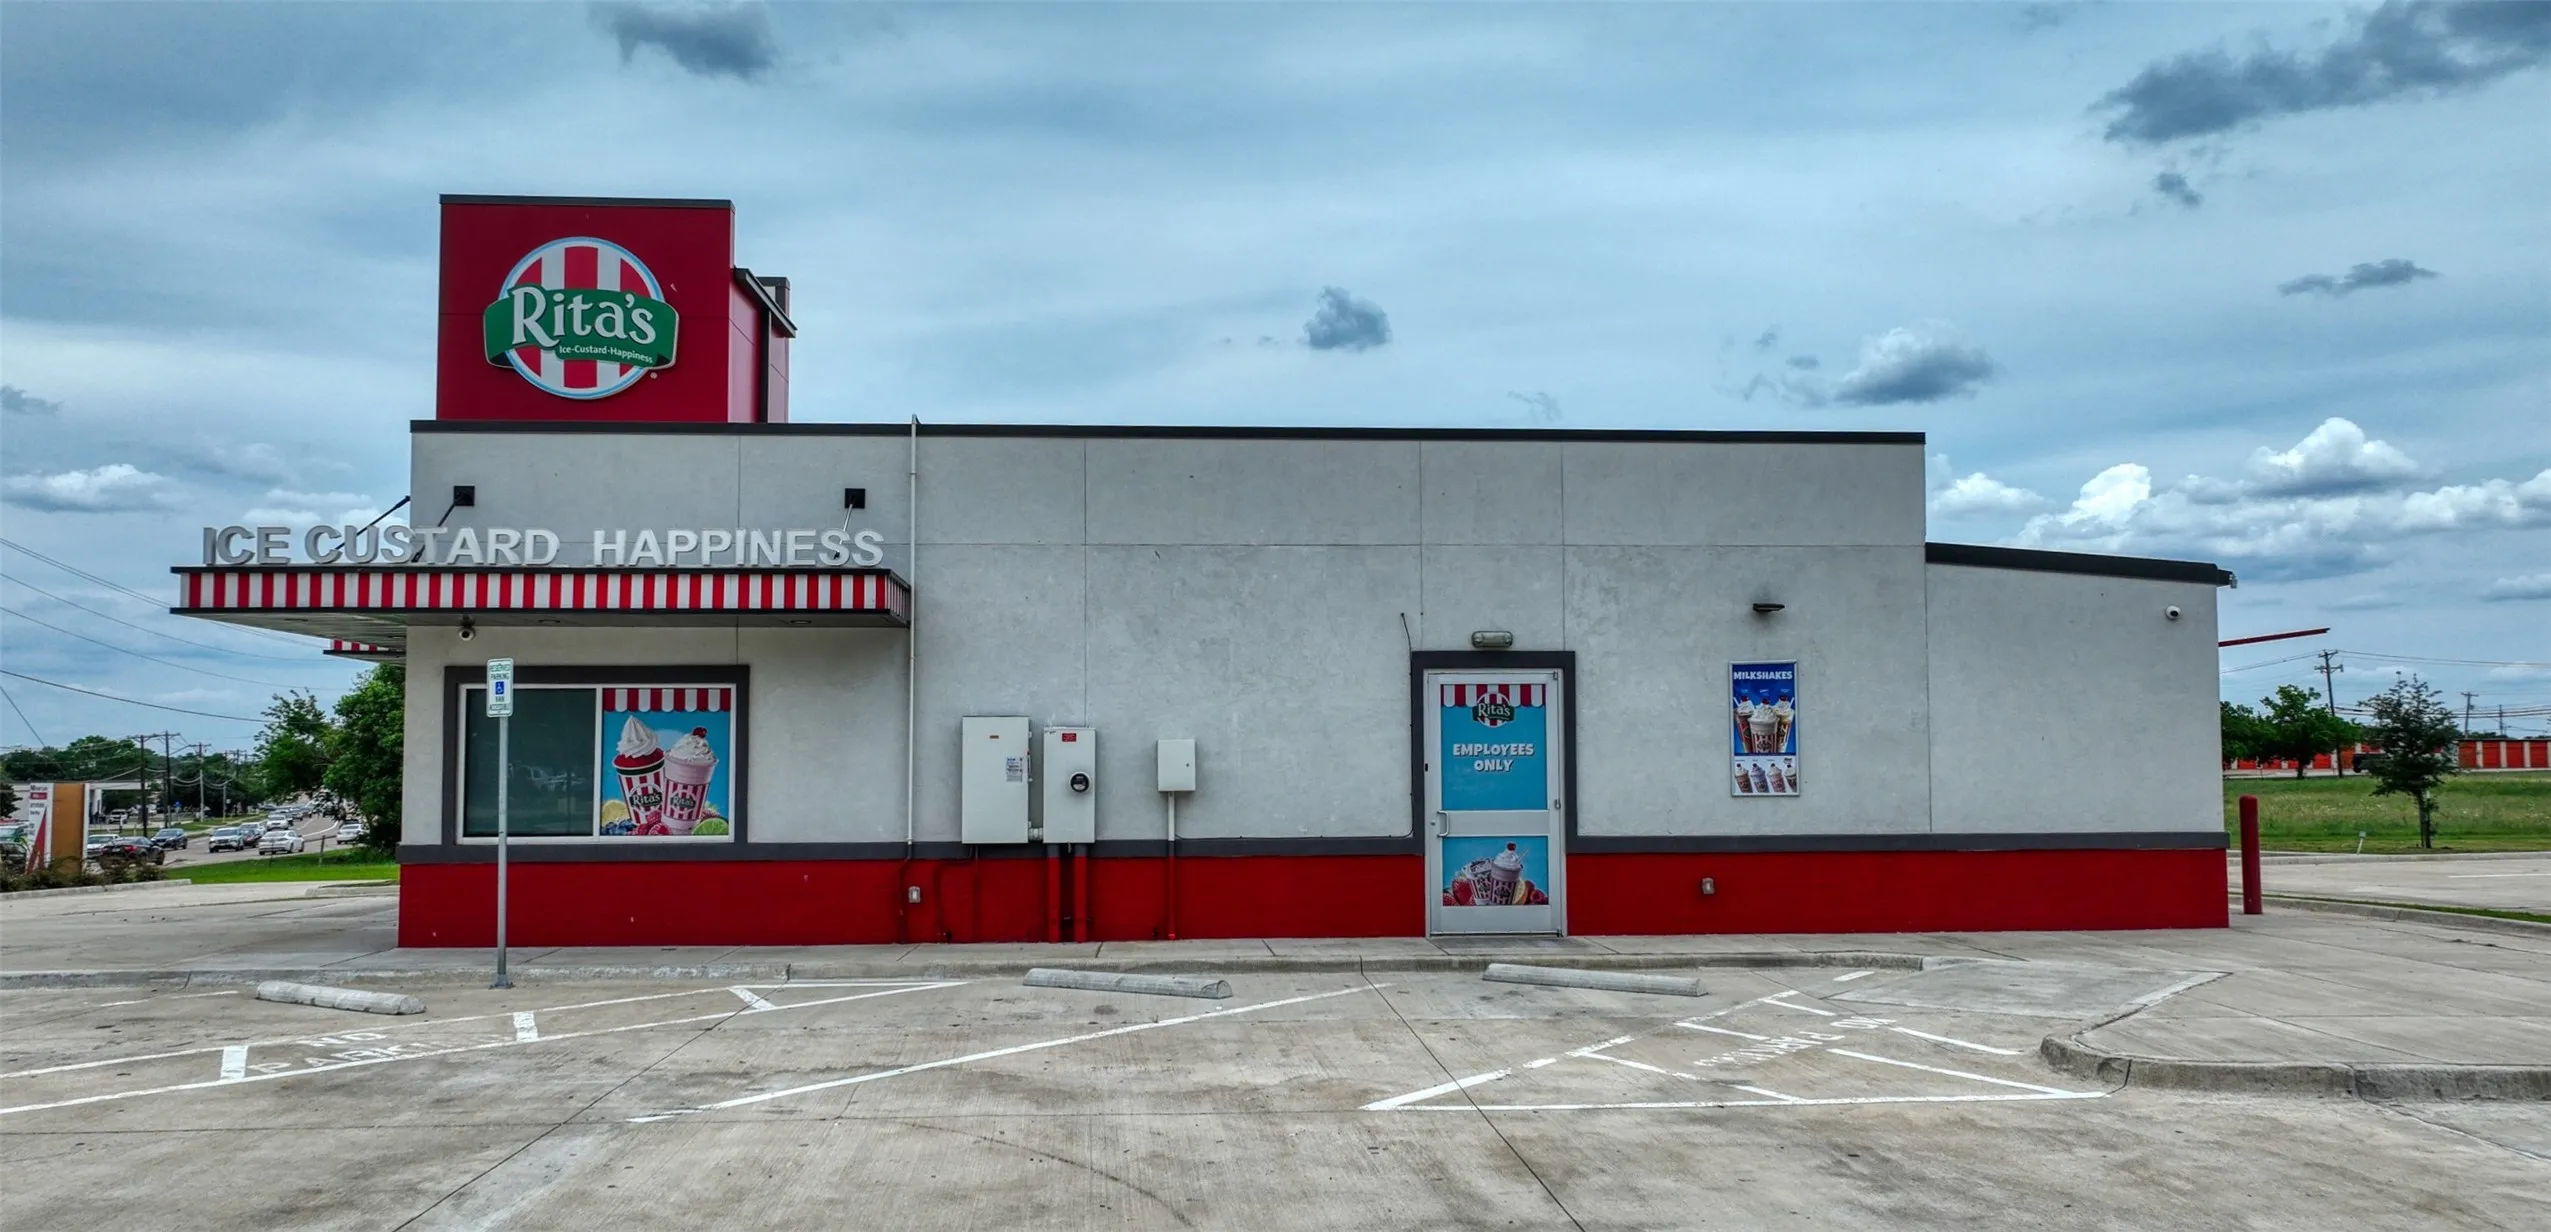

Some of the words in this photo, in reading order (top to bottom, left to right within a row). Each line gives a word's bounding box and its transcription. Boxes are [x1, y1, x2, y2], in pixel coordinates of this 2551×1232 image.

[511, 286, 656, 347] Rita's
[203, 526, 291, 565] ICE
[304, 525, 559, 565] CUSTARD
[593, 527, 885, 567] HAPPINESS
[1733, 671, 1793, 680] MILKSHAKES
[1478, 702, 1511, 717] Rita's
[1453, 743, 1534, 756] EMPLOYEES
[1474, 759, 1514, 772] ONLY
